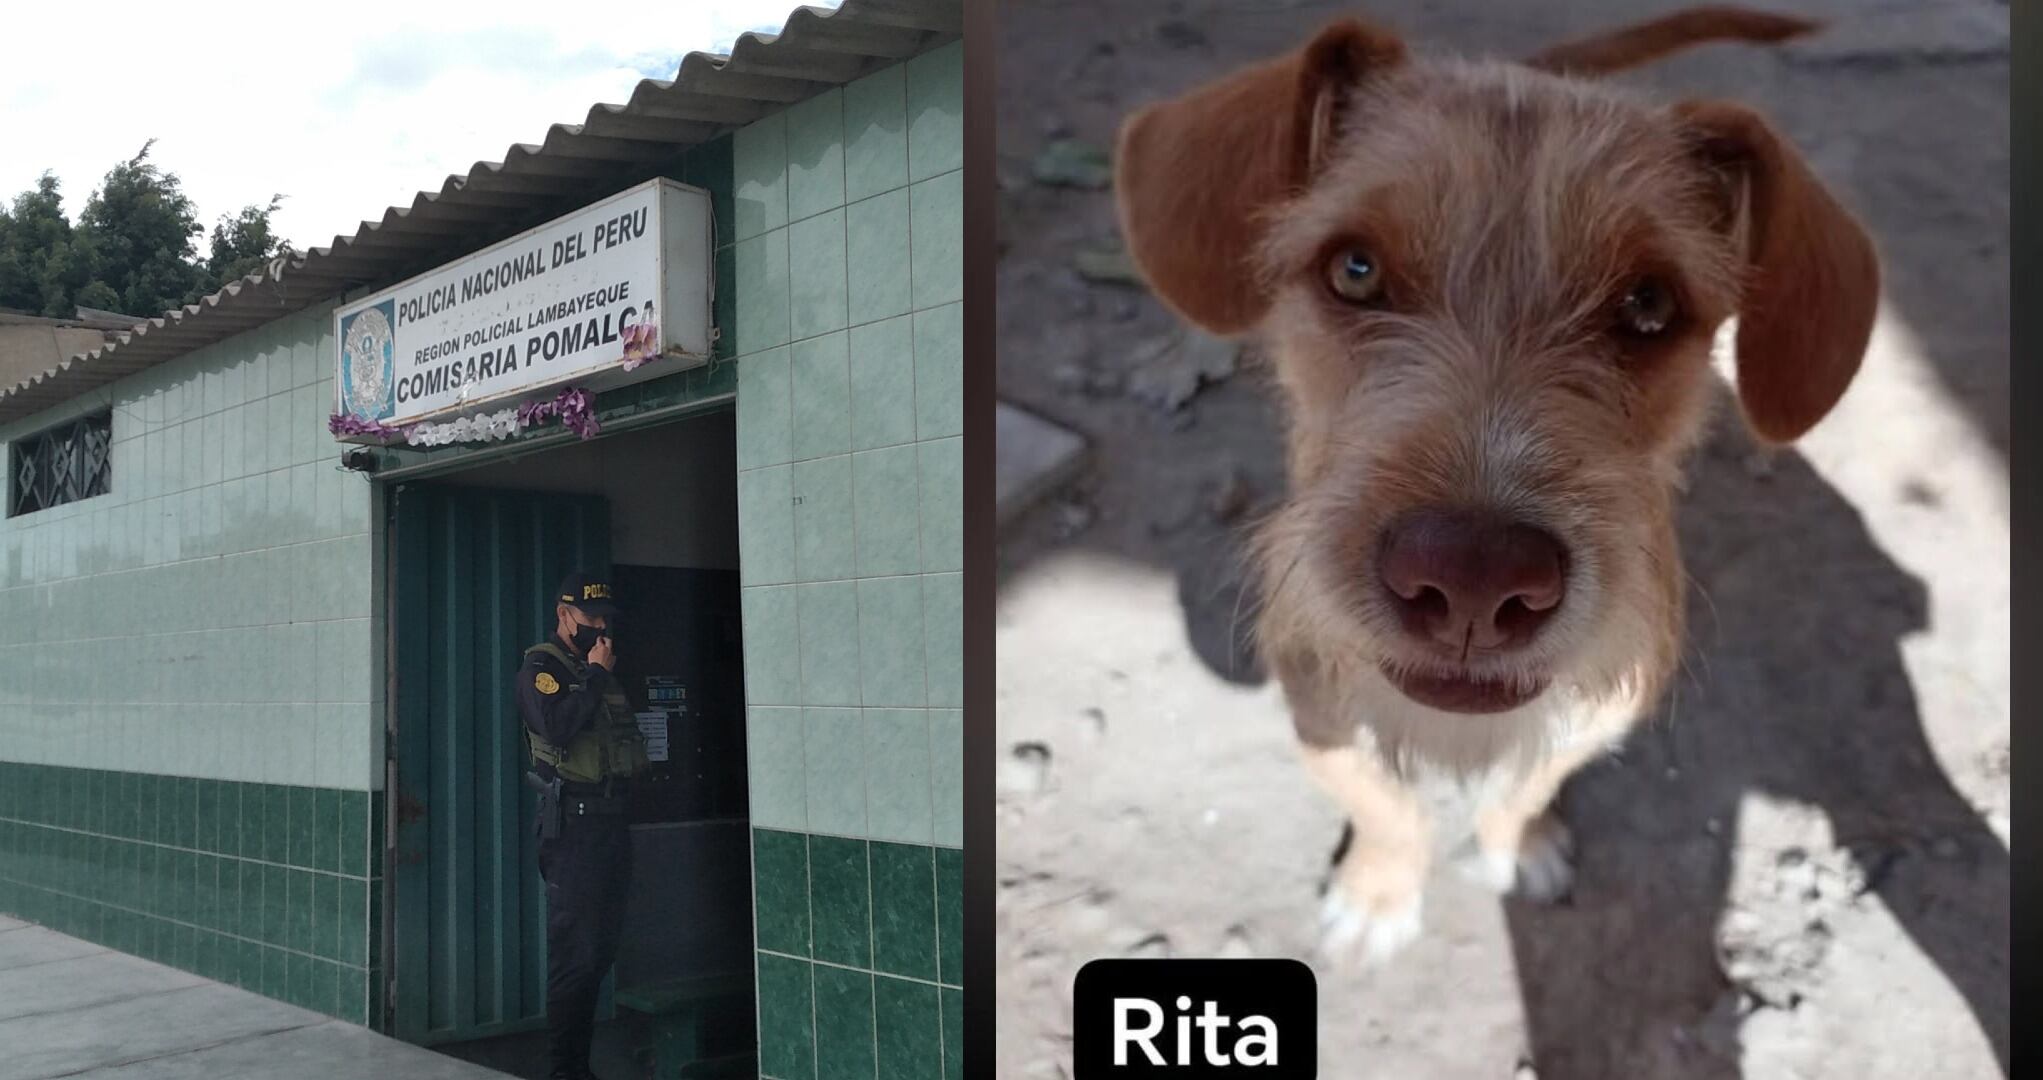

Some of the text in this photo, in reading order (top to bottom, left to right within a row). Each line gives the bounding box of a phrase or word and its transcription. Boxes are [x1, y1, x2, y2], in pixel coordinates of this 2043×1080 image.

[399, 206, 648, 327] POLICIA NACIONAL DEL PERU
[396, 300, 655, 404] COMISARIA POMALCA
[414, 281, 630, 367] REGION POLICIAL LAMBAYEQUE
